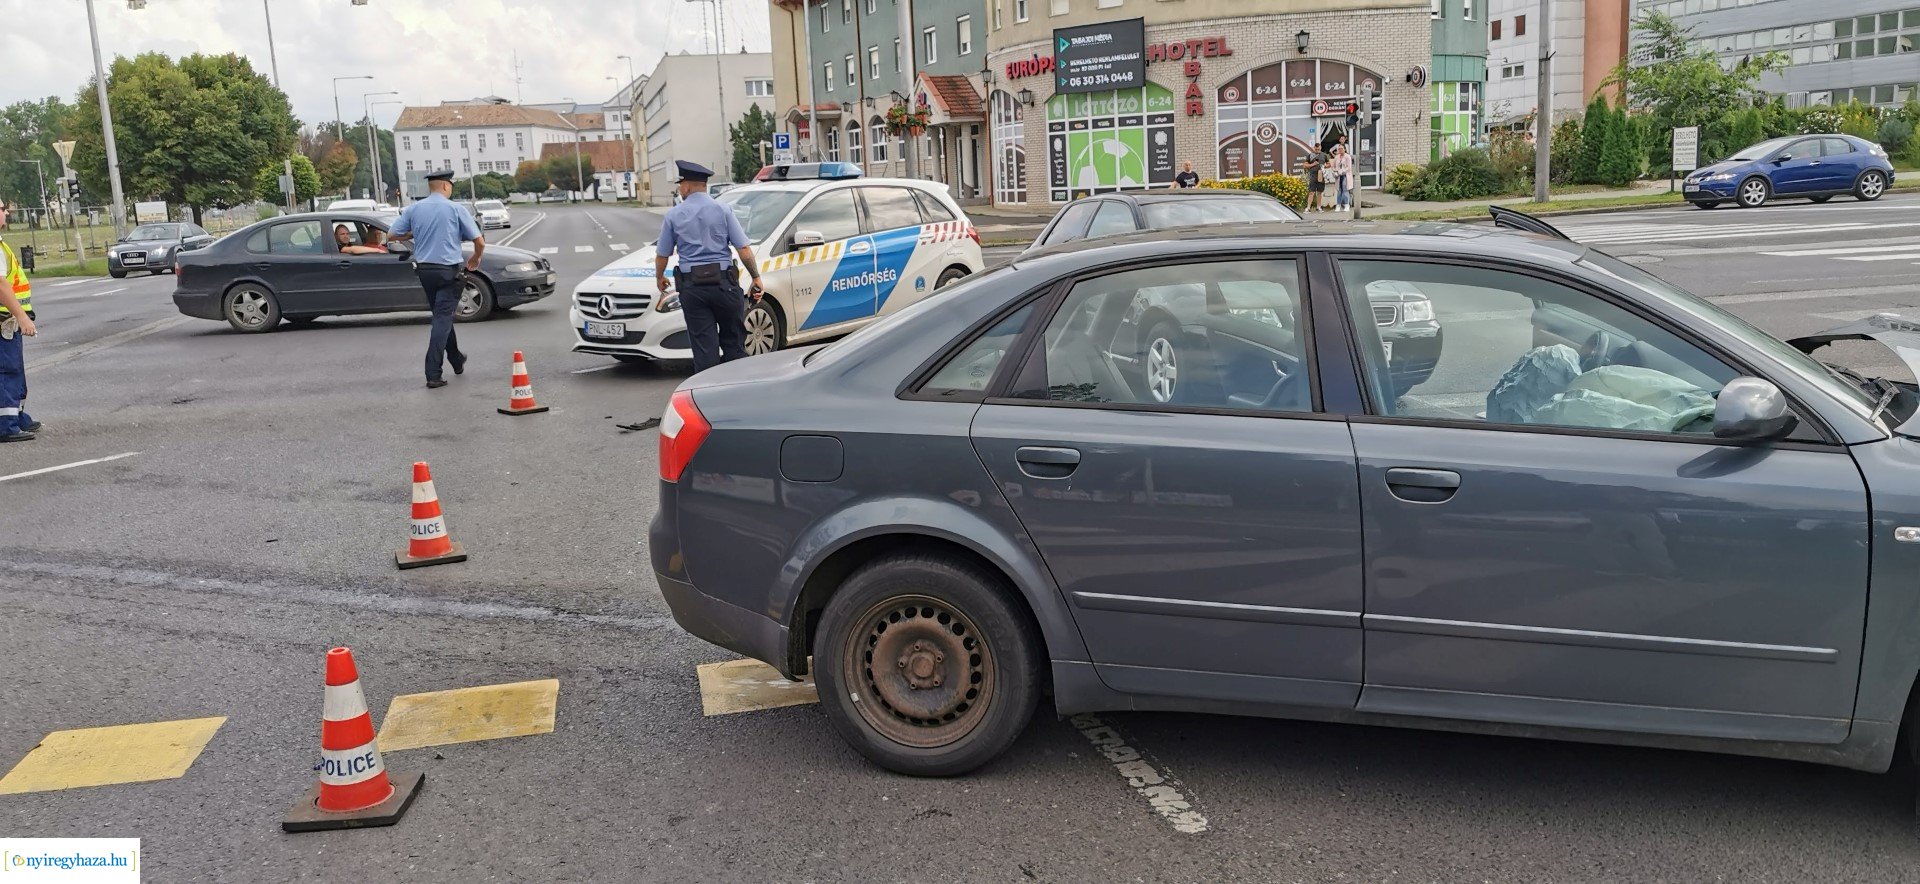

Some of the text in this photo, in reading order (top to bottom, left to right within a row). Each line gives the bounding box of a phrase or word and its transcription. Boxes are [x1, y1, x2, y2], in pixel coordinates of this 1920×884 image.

[1148, 36, 1232, 61] HOTEL
[1069, 71, 1133, 87] 06 30 314 0448
[1290, 78, 1312, 88] 6-24
[1256, 85, 1277, 95] 6-24
[1324, 81, 1346, 91] 6-24
[1148, 96, 1171, 107] 6-24
[778, 136, 787, 148] P
[832, 267, 897, 292] RENDŐRSÉG
[800, 287, 812, 296] 112
[589, 323, 622, 335] PNL-452
[411, 522, 441, 535] OLICE
